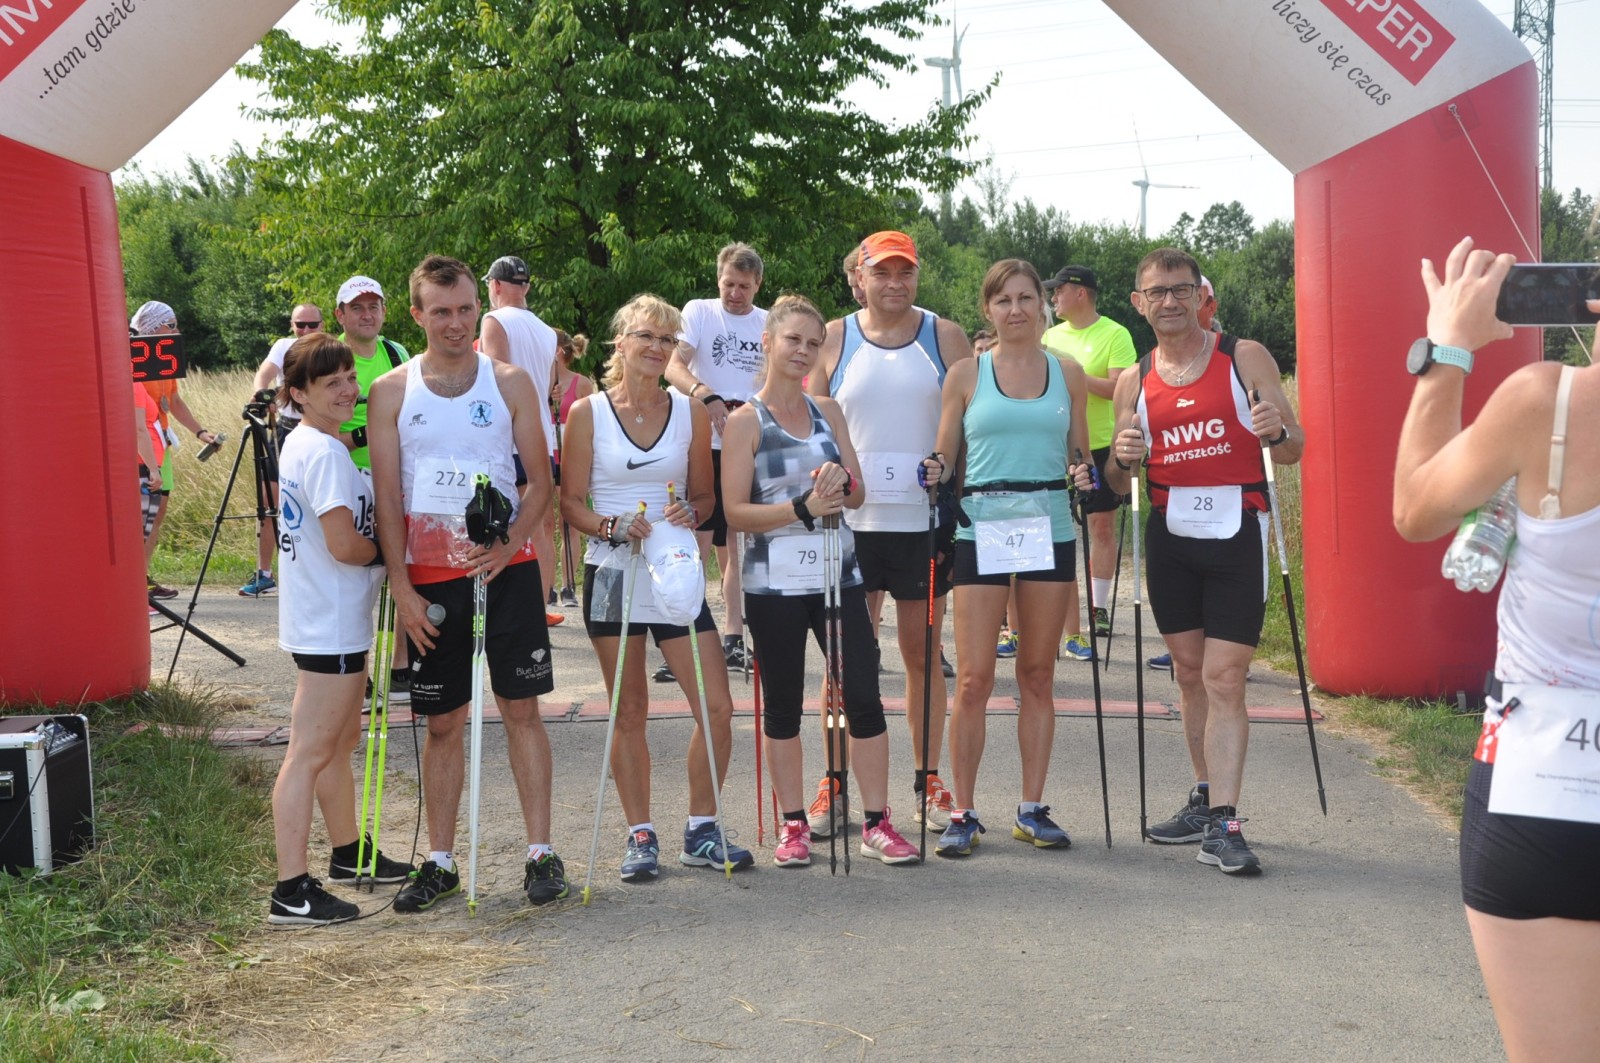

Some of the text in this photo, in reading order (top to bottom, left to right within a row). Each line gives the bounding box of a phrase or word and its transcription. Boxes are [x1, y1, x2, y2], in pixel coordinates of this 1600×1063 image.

[1345, 0, 1433, 62] PER
[1318, 40, 1349, 71] się
[1347, 67, 1391, 106] czas
[130, 339, 178, 379] 25
[1161, 418, 1225, 449] NWG
[1163, 442, 1231, 465] PRZYSZŁOŚĆ
[435, 470, 466, 487] 272
[885, 466, 895, 481] 5
[1193, 496, 1213, 511] 28
[1005, 533, 1025, 548] 47
[797, 550, 817, 565] 79
[516, 667, 532, 676] Blue
